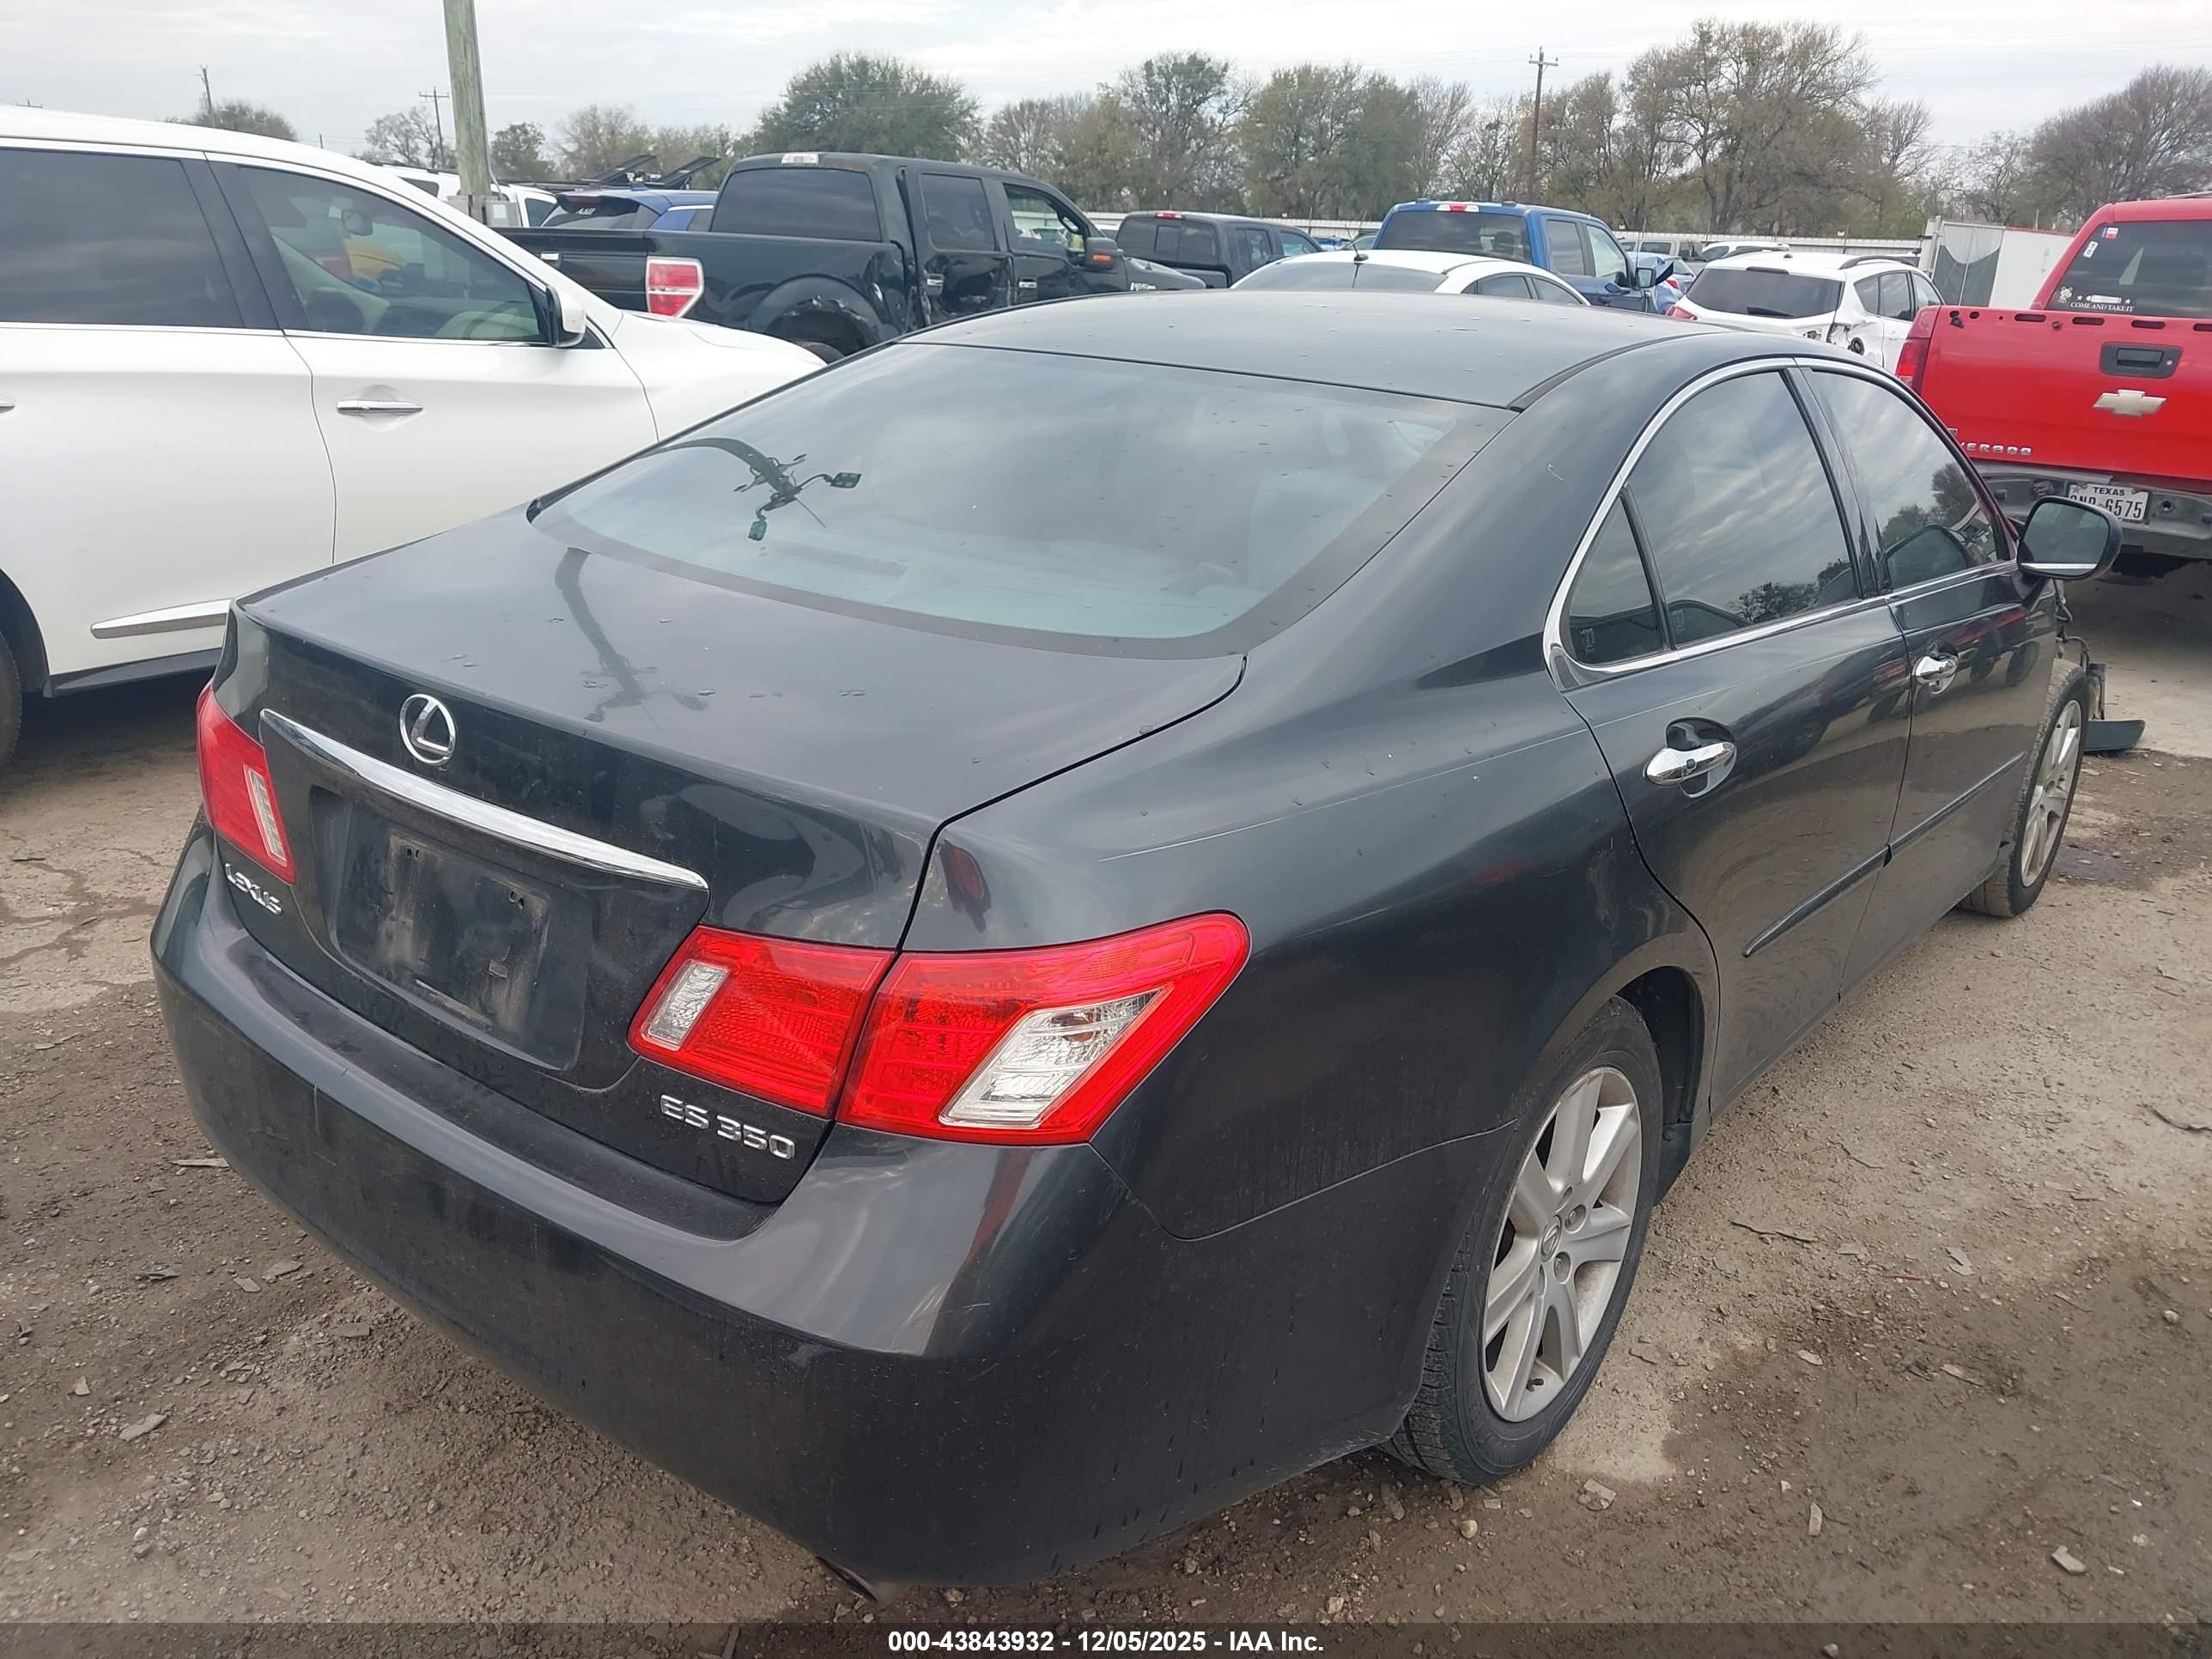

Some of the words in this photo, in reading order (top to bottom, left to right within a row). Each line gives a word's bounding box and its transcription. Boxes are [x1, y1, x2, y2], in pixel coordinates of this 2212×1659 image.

[2093, 487, 2125, 496] TEXAS
[225, 862, 283, 915] LEXUS
[660, 1094, 710, 1130] ES
[716, 1114, 796, 1160] 350
